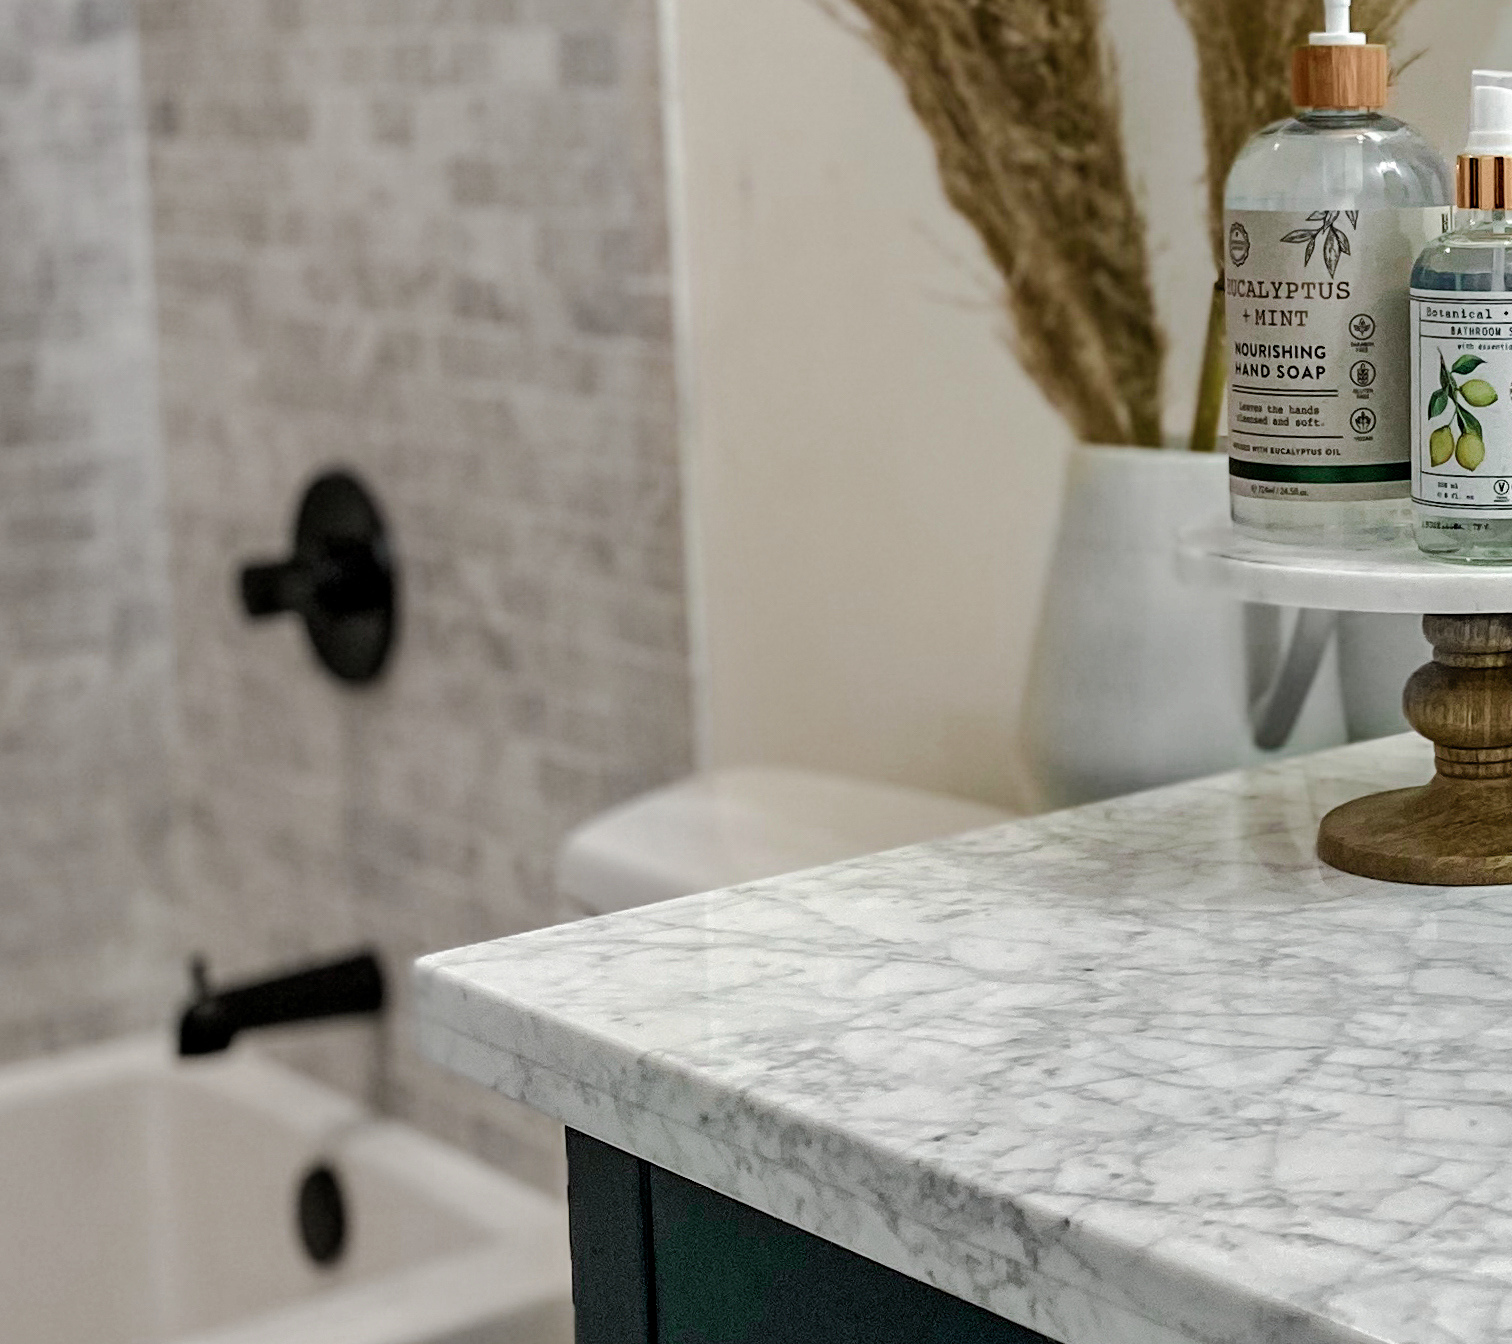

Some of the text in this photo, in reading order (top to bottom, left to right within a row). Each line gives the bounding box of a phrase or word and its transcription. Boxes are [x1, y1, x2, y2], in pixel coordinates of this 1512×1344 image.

[1255, 309, 1309, 327] MINT
[1426, 307, 1493, 319] Botanical
[1450, 326, 1501, 336] BATHROOM
[1235, 341, 1327, 360] NOURISHING
[1235, 364, 1326, 381] HAND SOAP
[1267, 405, 1284, 414] the
[1289, 405, 1320, 415] hands
[1272, 417, 1289, 426] and
[1270, 447, 1322, 456] EUCALYPTUS
